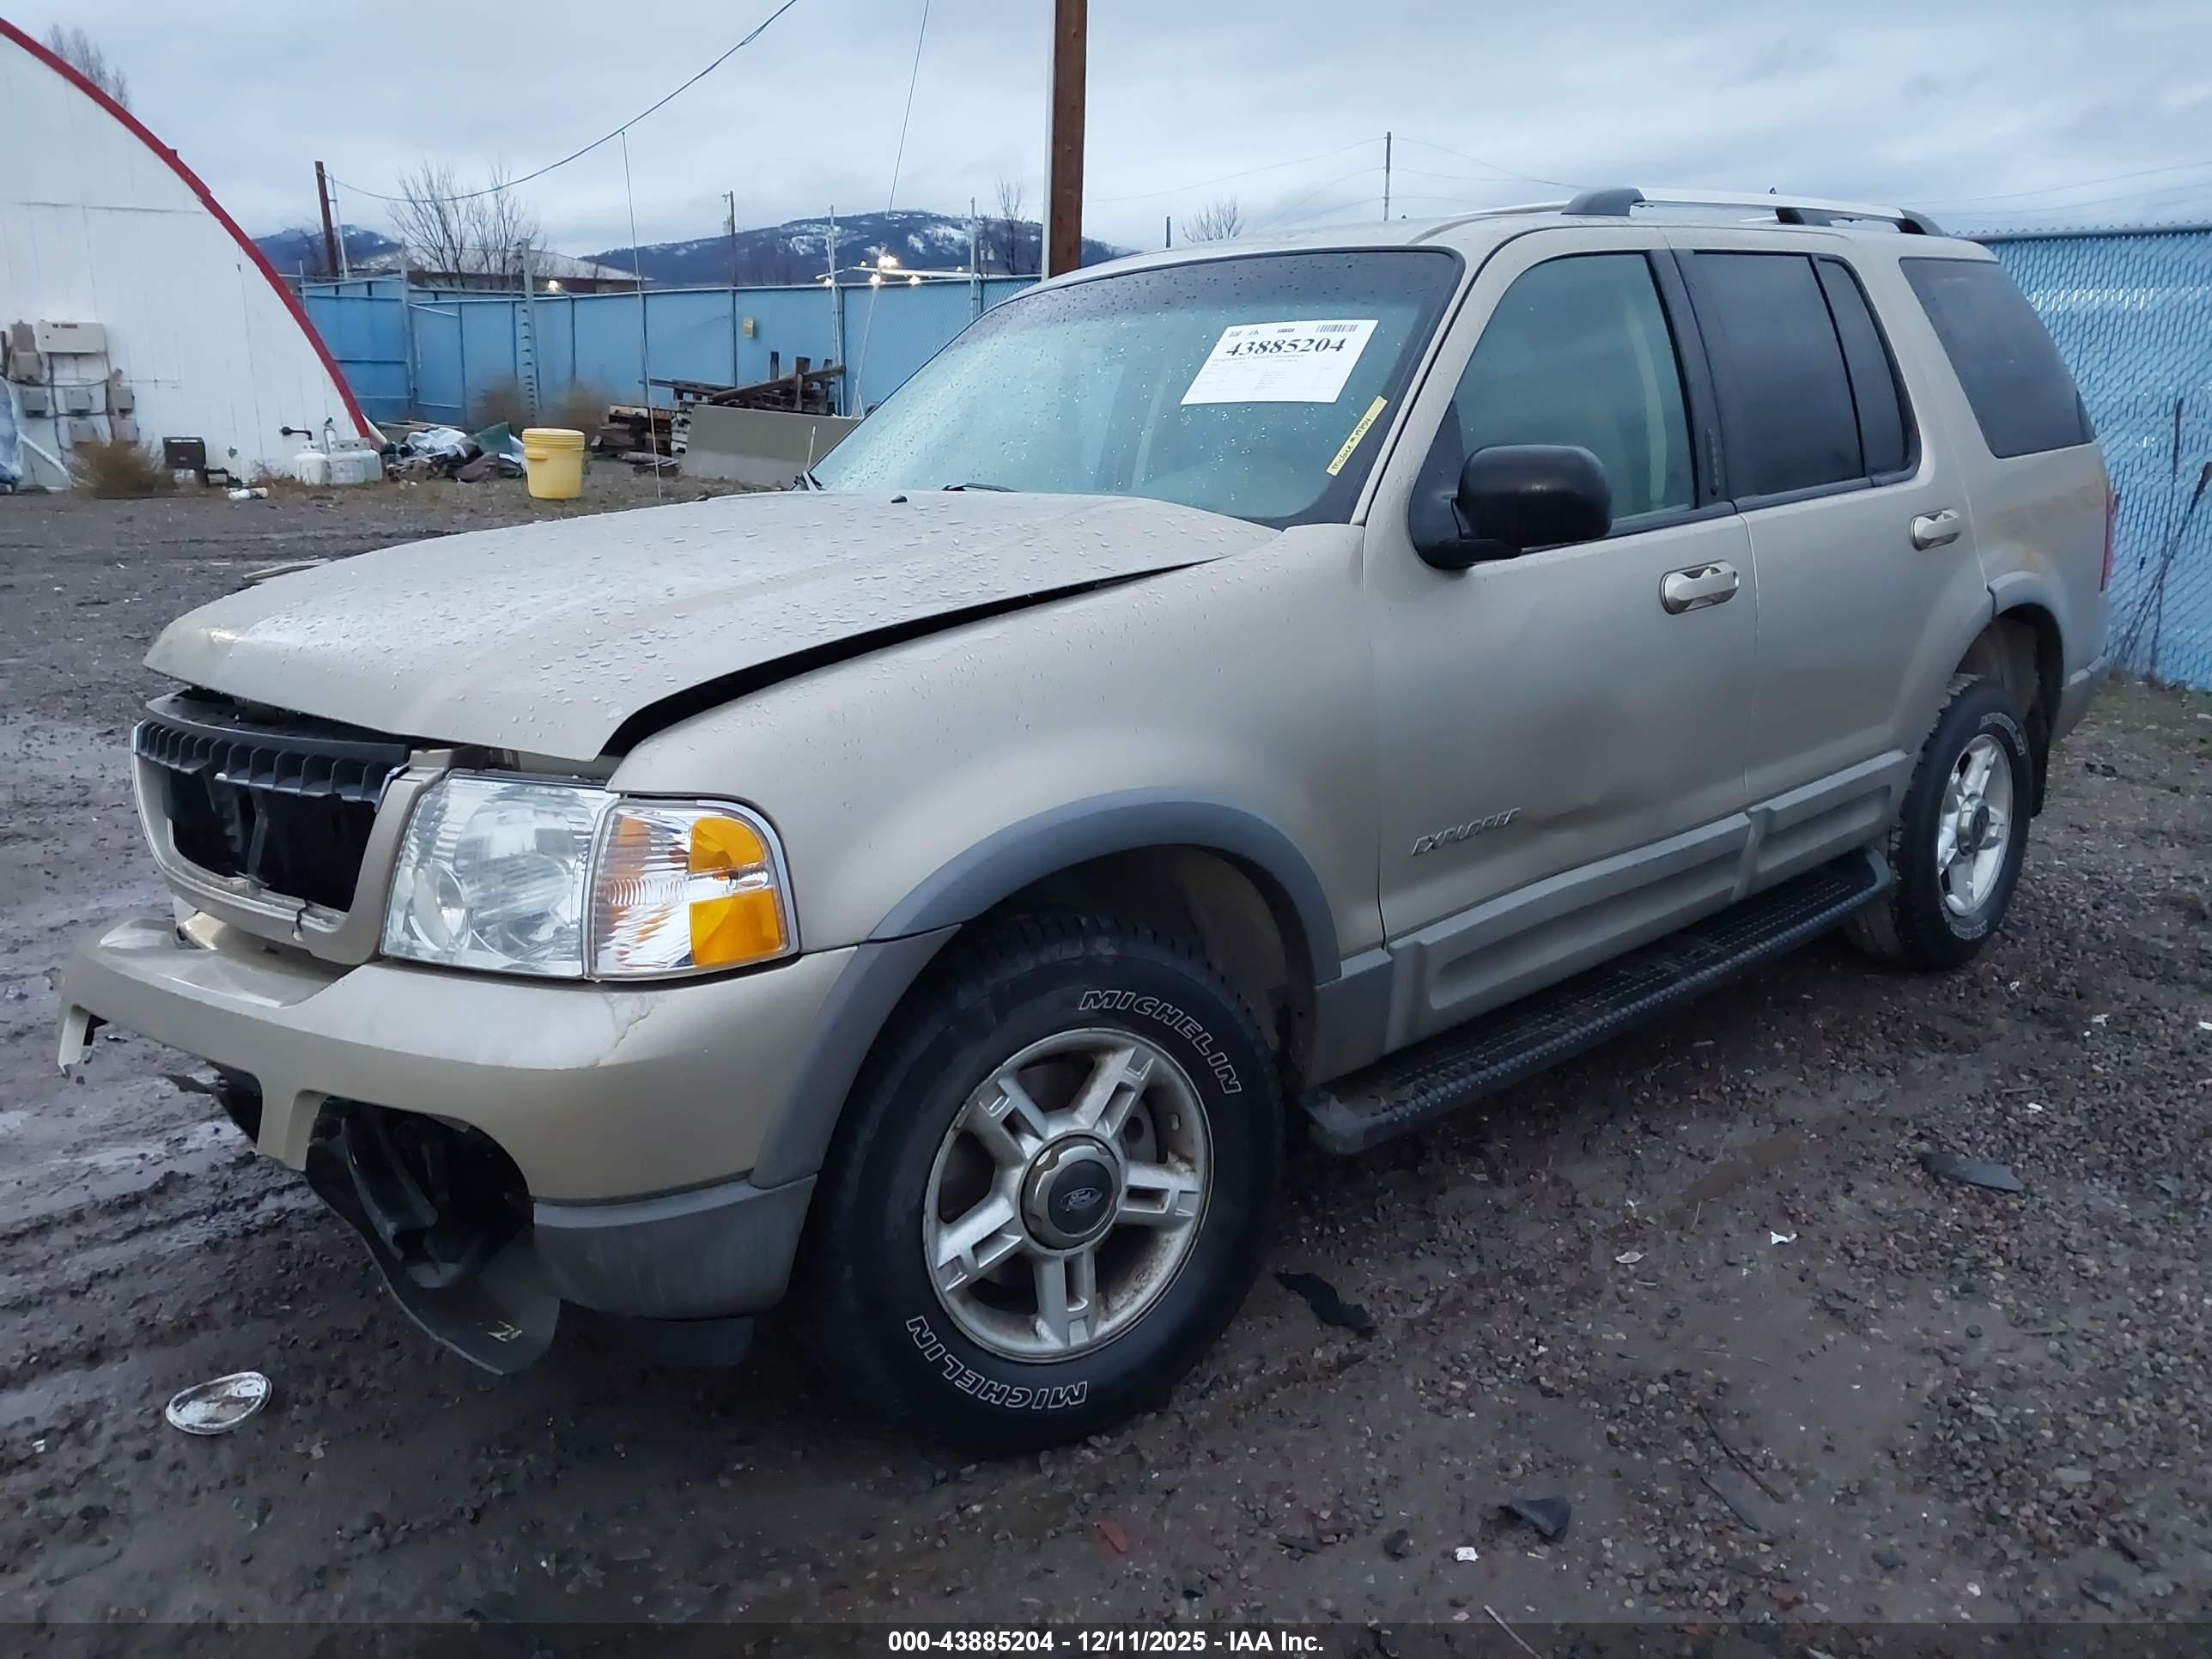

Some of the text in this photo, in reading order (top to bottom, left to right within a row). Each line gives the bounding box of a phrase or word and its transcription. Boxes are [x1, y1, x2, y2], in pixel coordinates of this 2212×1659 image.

[1226, 337, 1346, 356] 43885204
[1079, 990, 1243, 1094] MICHELIN
[906, 1316, 1088, 1409] MICHELIN
